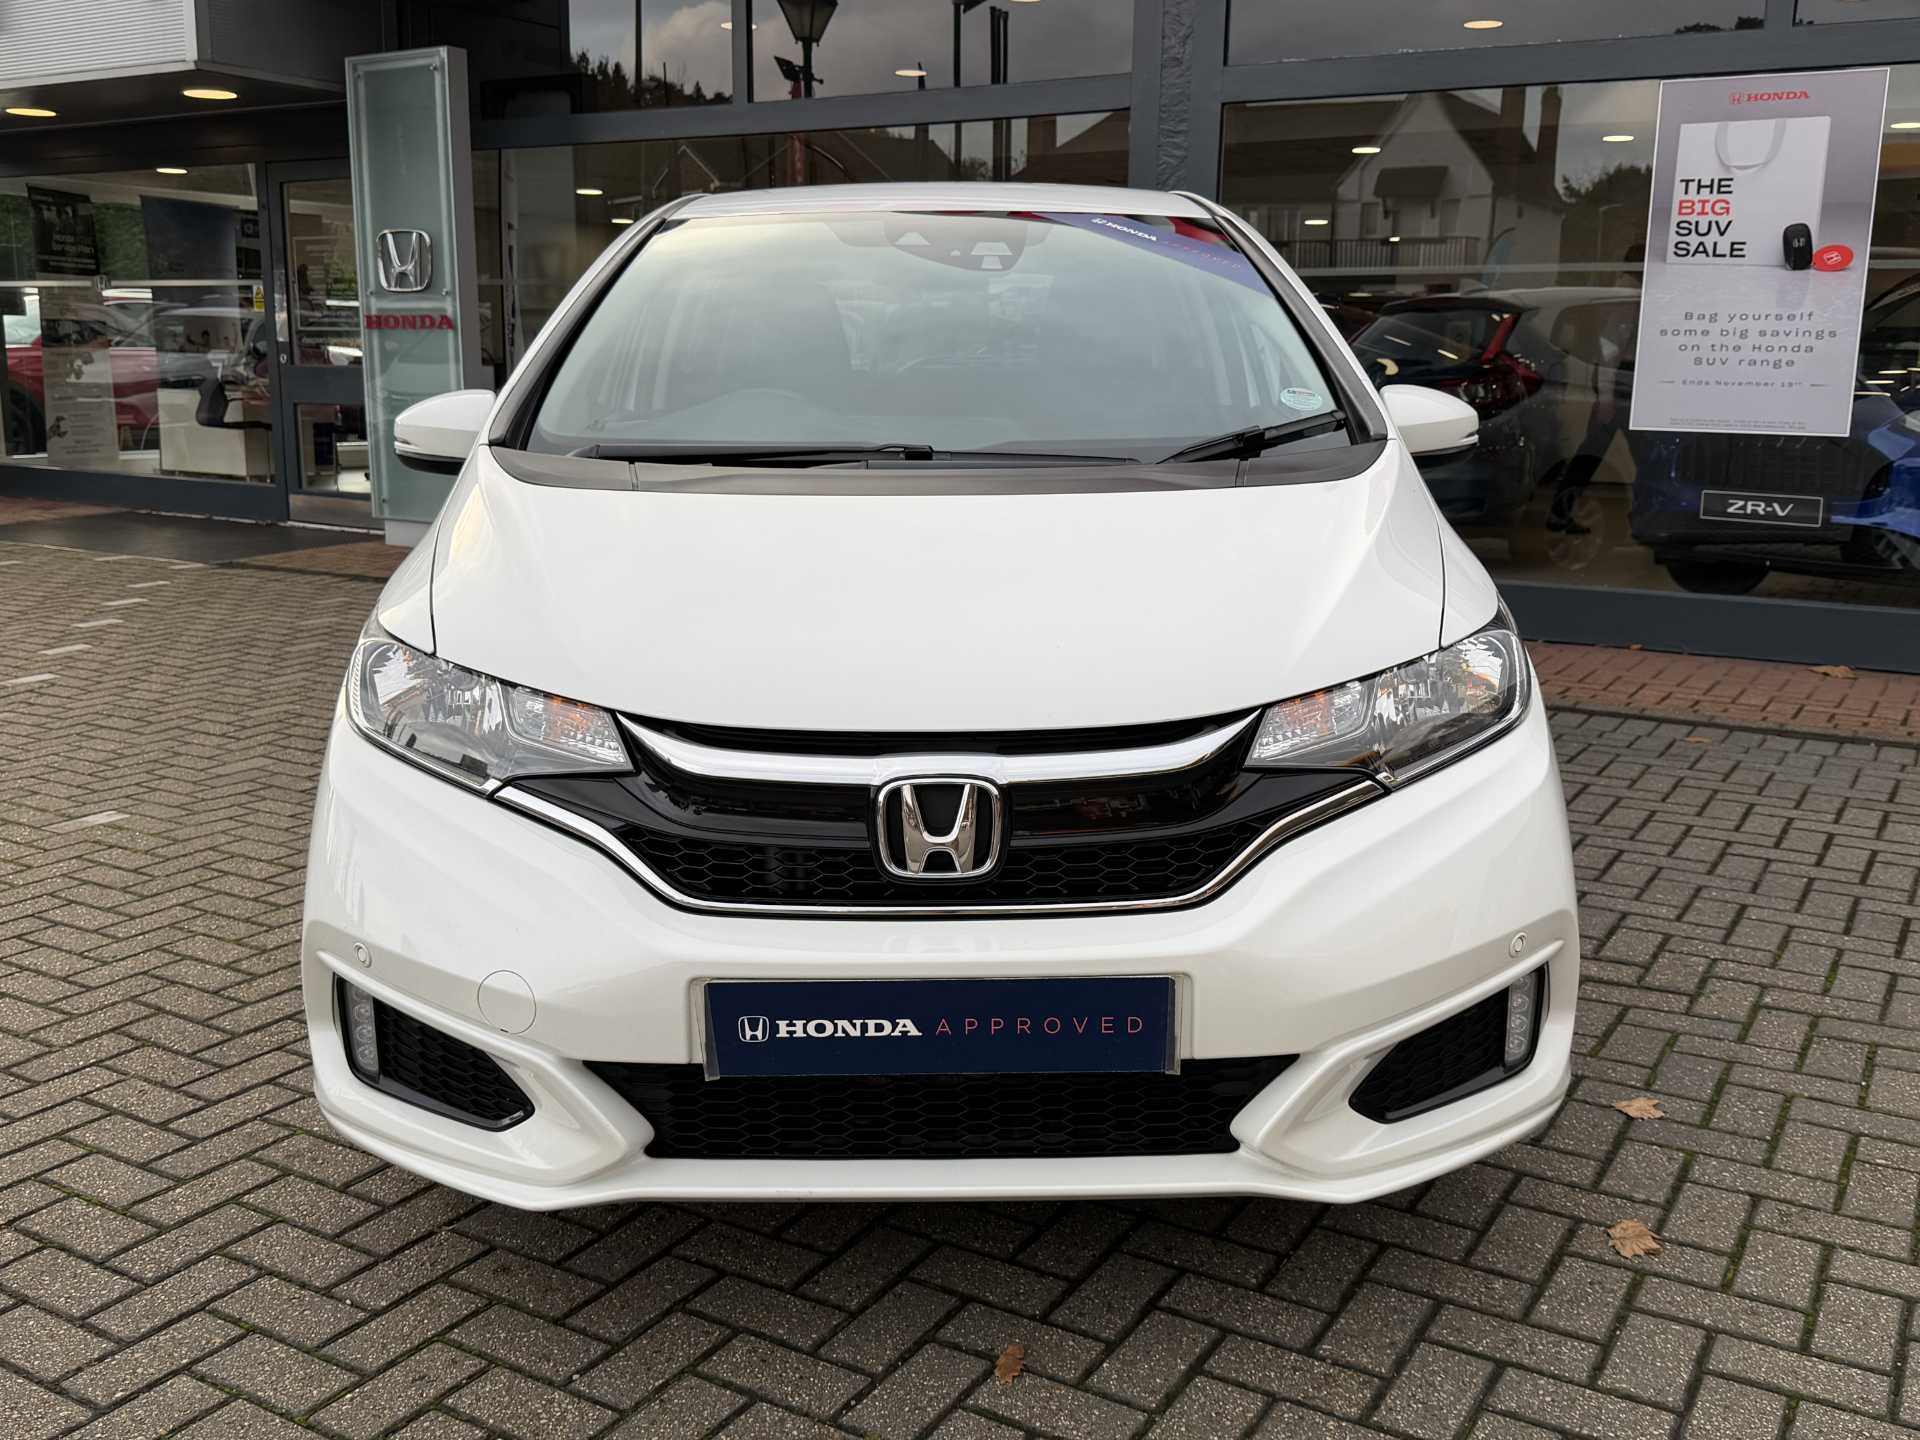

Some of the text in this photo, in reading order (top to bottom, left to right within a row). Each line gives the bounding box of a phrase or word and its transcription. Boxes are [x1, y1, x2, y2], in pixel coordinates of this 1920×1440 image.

[1747, 90, 1809, 102] HONDA
[1679, 177, 1734, 195] THE
[1677, 199, 1730, 216] BIG
[1105, 222, 1157, 241] HONDA
[1675, 220, 1733, 237] SUV
[1673, 241, 1747, 258] SALE
[366, 314, 455, 331] HONDA
[1684, 311, 1815, 323] Bag yourself
[1659, 327, 1838, 341] some big savings
[1678, 343, 1815, 353] on the Honda
[1693, 356, 1797, 370] SUV range
[1726, 499, 1794, 517] ZR-V
[775, 1016, 1144, 1038] HONDA APPROVED
